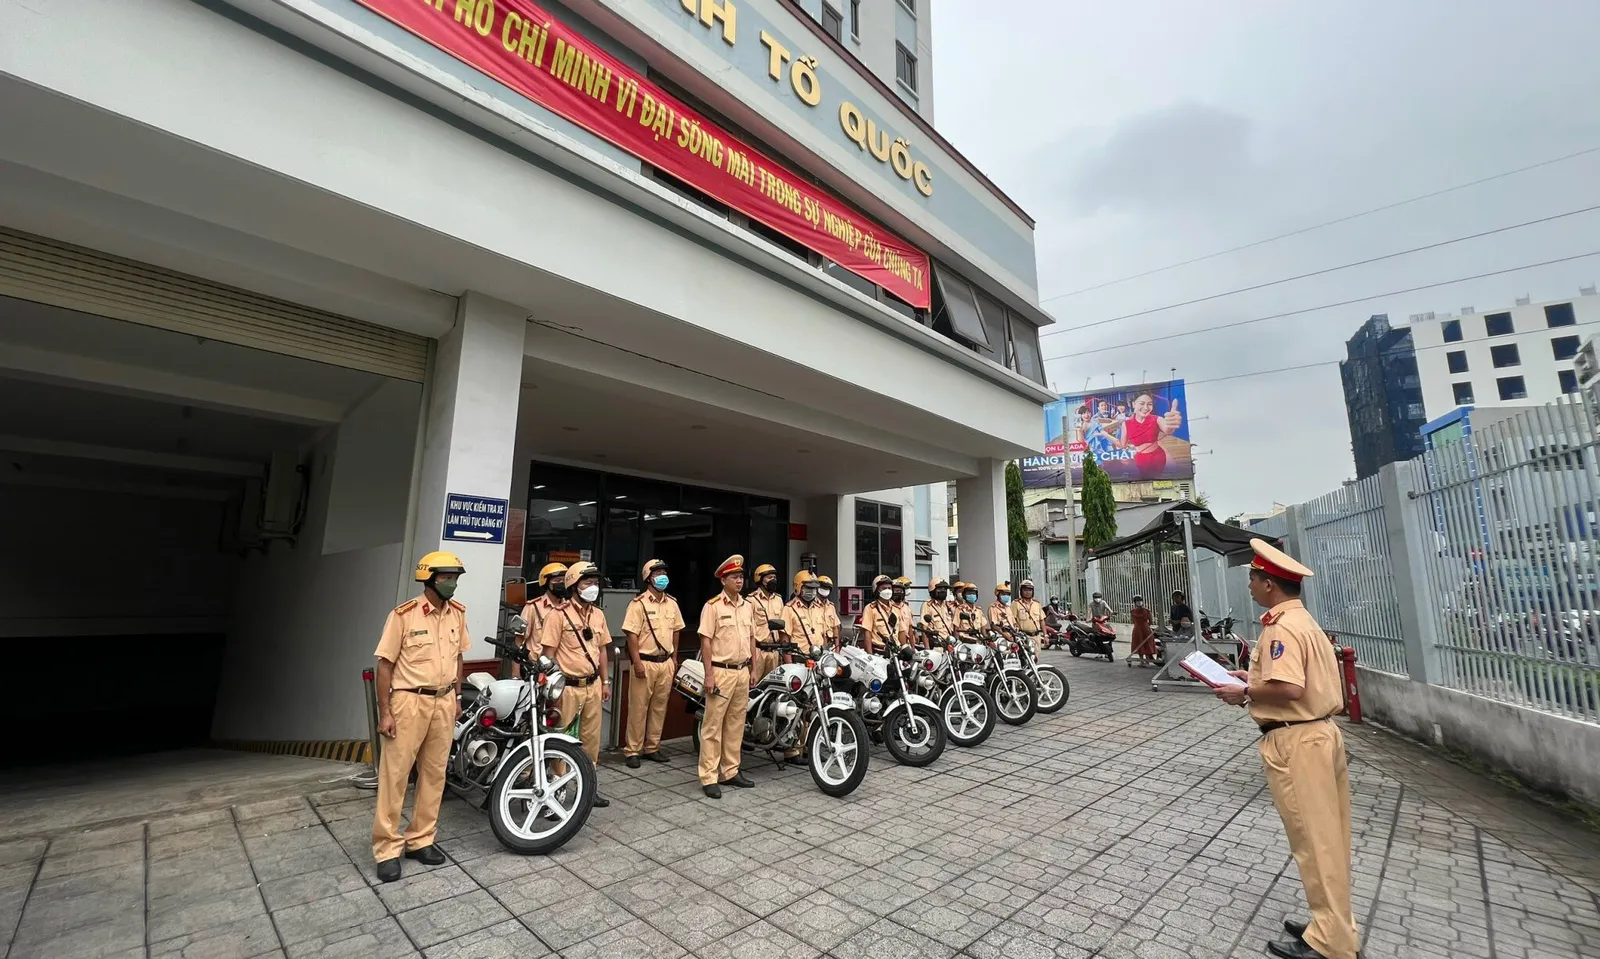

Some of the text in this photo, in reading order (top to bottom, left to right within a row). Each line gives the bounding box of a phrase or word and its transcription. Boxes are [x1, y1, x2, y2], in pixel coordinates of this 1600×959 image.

[760, 30, 821, 106] TỔ
[839, 102, 933, 197] QUỐC
[502, 12, 551, 67] CHÍ
[550, 39, 612, 104] MINH
[639, 92, 675, 141] ĐẠI
[677, 117, 724, 169] SỐNG
[726, 147, 755, 188] MÃI
[758, 166, 802, 216] TRONG
[804, 196, 820, 230] SỰ
[823, 208, 862, 251] NGHIỆP
[864, 231, 882, 265] CỦA
[883, 247, 911, 284] CHÚNG
[912, 265, 924, 291] TA
[1057, 442, 1084, 452] LAADA
[1023, 456, 1058, 467] HÀNG
[450, 500, 462, 510] KHU
[487, 504, 497, 514] TRA
[497, 505, 504, 515] XE
